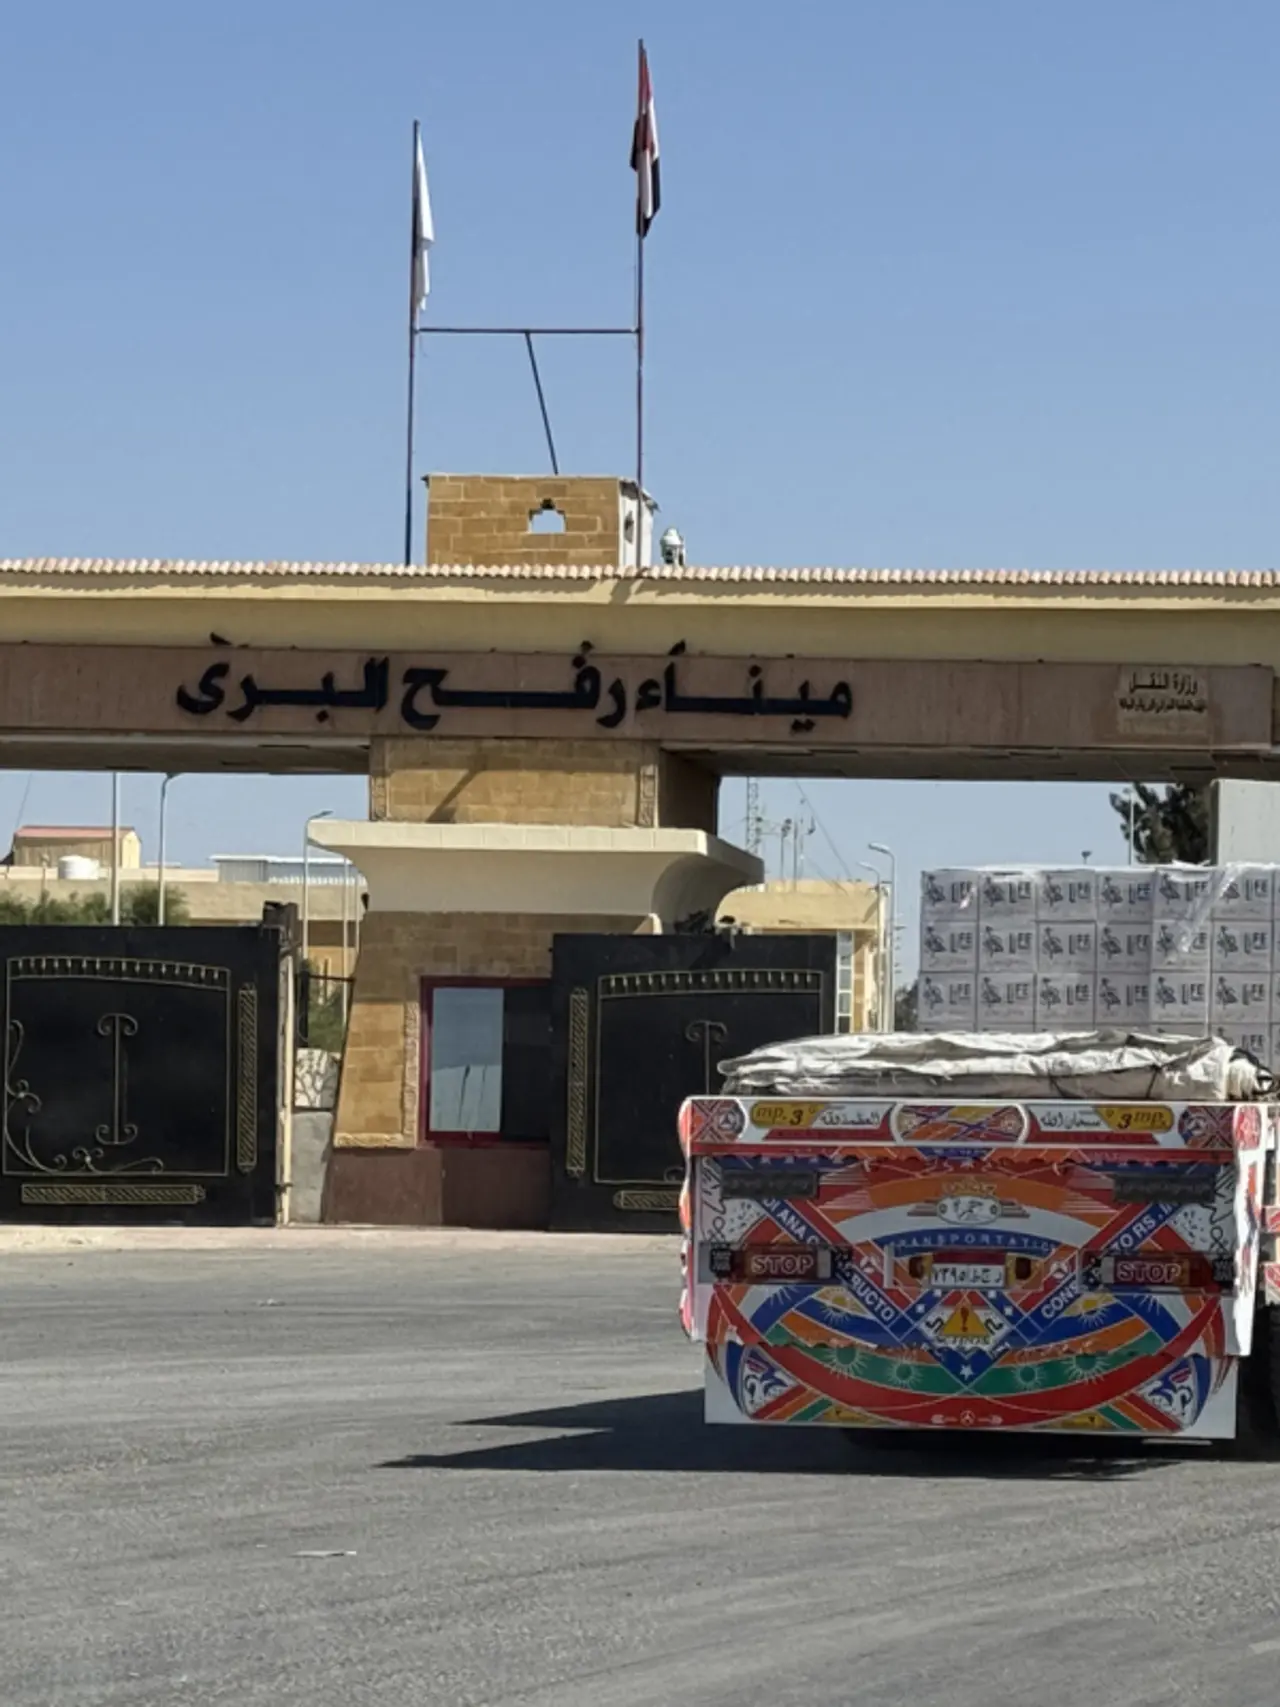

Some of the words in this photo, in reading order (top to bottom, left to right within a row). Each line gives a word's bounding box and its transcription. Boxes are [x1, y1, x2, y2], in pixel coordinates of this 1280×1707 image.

[401, 652, 627, 731] رفح
[636, 652, 853, 733] ميناء
[789, 1107, 803, 1125] 3
[1117, 1113, 1133, 1129] 3
[751, 1255, 814, 1275] STOP
[1116, 1262, 1182, 1282] STOP
